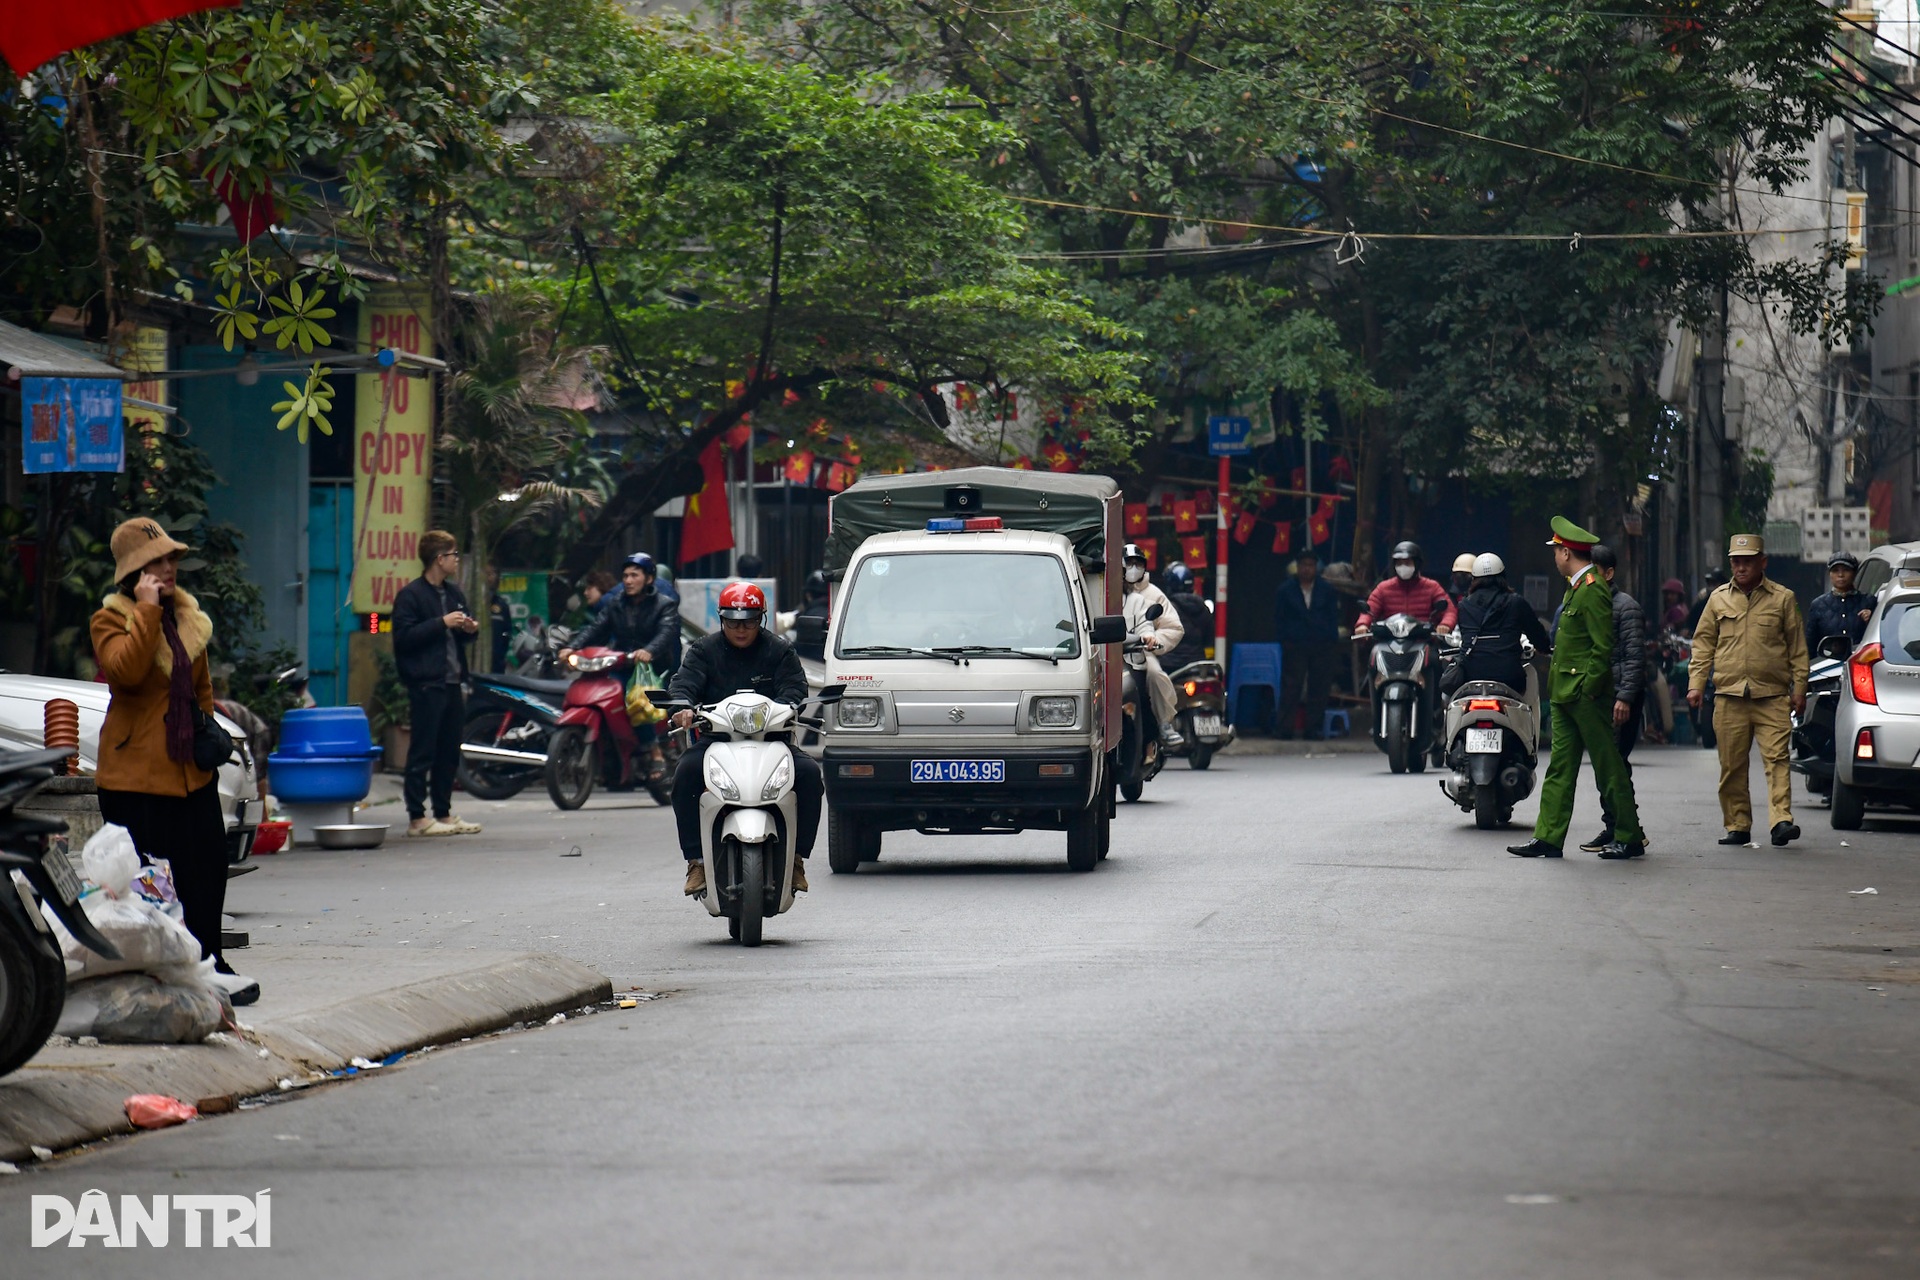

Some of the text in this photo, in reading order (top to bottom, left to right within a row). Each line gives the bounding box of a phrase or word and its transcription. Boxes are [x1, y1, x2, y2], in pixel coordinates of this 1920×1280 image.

[371, 313, 420, 355] PHO
[360, 430, 426, 476] COPY
[383, 485, 403, 515] IN
[366, 524, 417, 567] LUẬN
[835, 680, 884, 688] CARRY
[913, 762, 1002, 780] 29A-043.95
